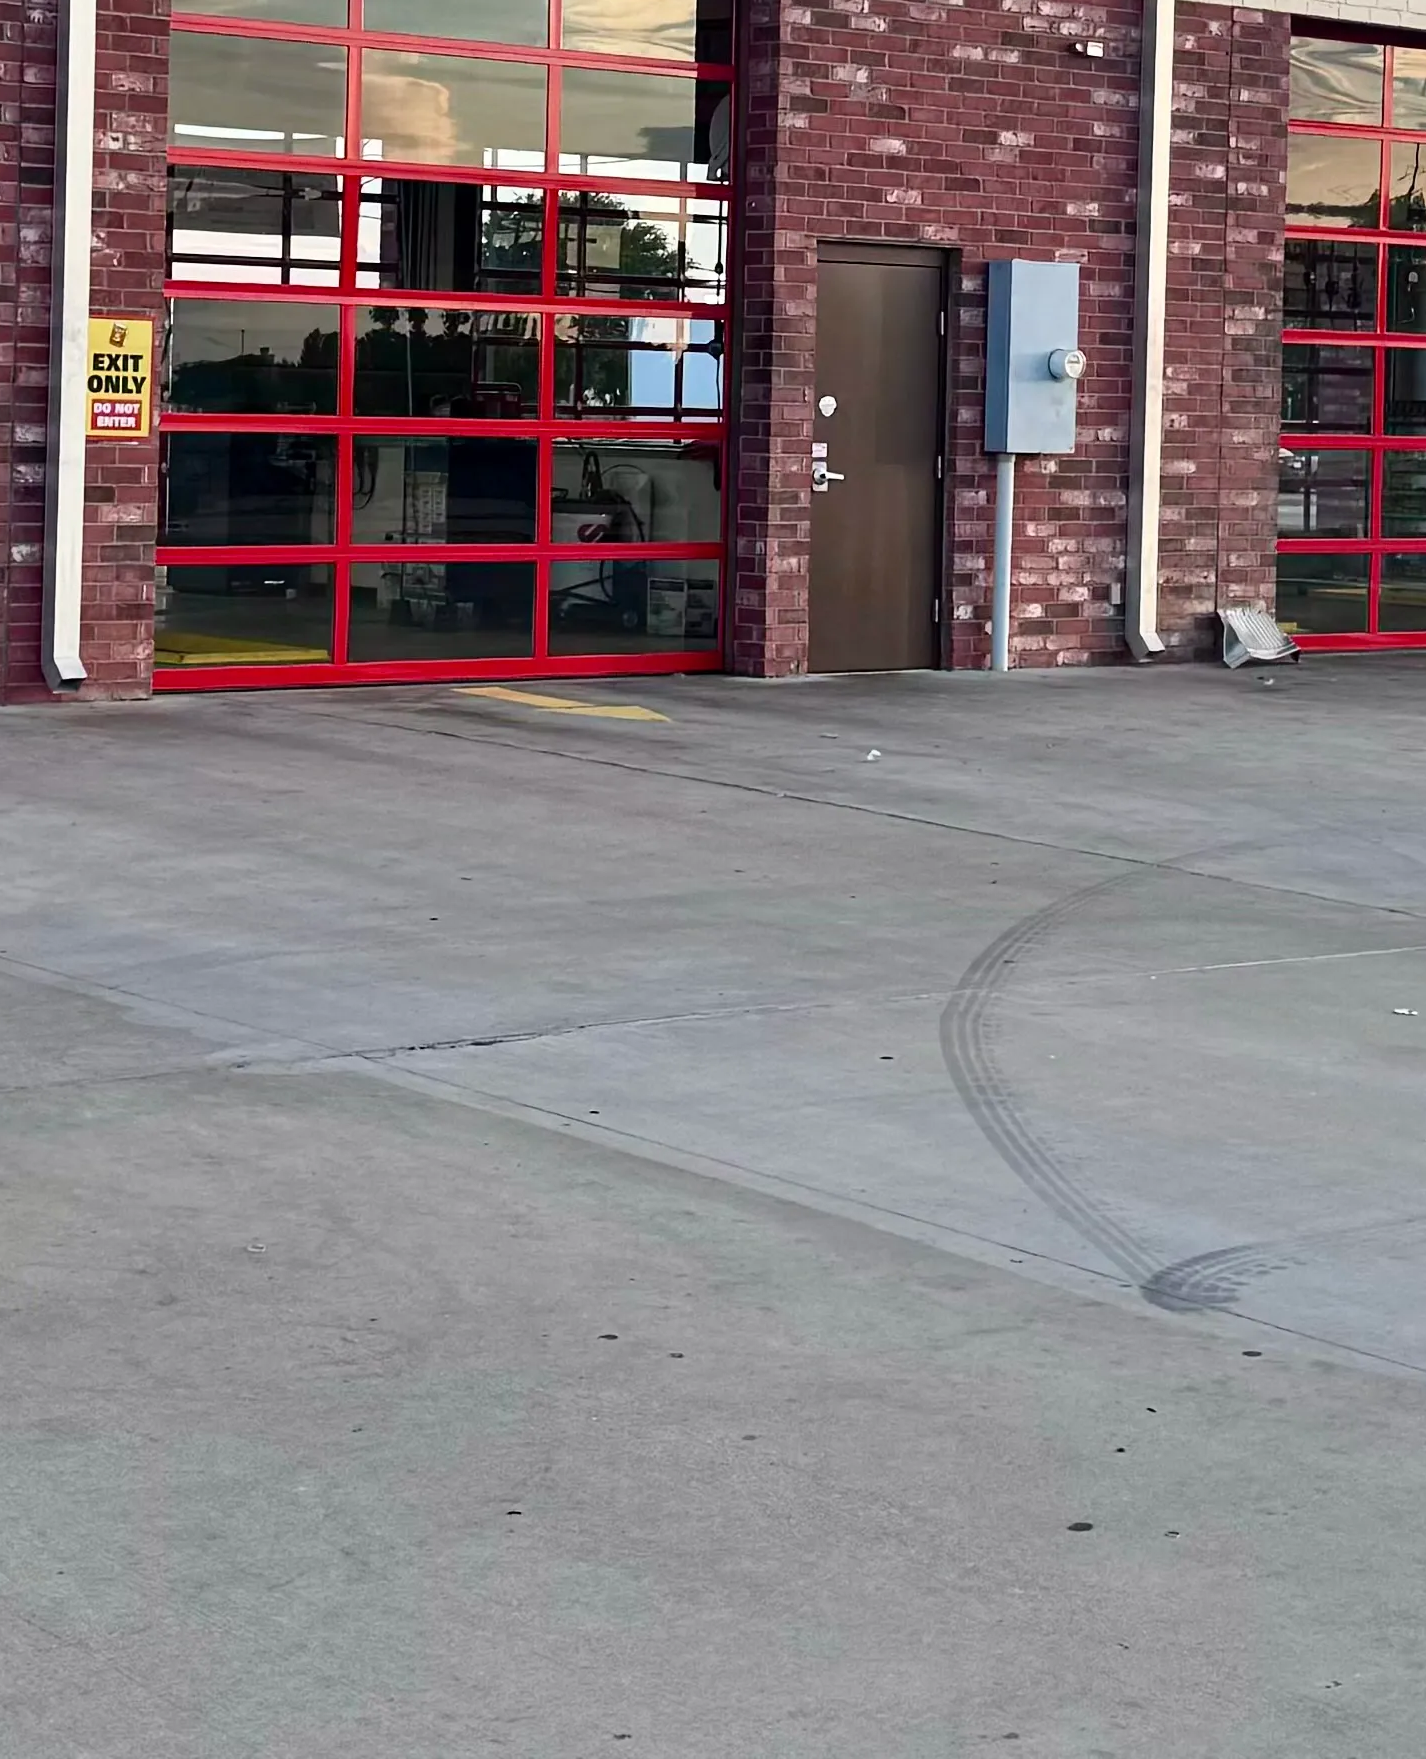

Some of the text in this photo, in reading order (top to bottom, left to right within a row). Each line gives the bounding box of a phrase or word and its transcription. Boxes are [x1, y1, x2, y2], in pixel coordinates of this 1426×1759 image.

[92, 353, 144, 372] EXIT
[87, 374, 147, 394] ONLY
[93, 402, 141, 415] DO NOT
[96, 416, 136, 428] ENTER
